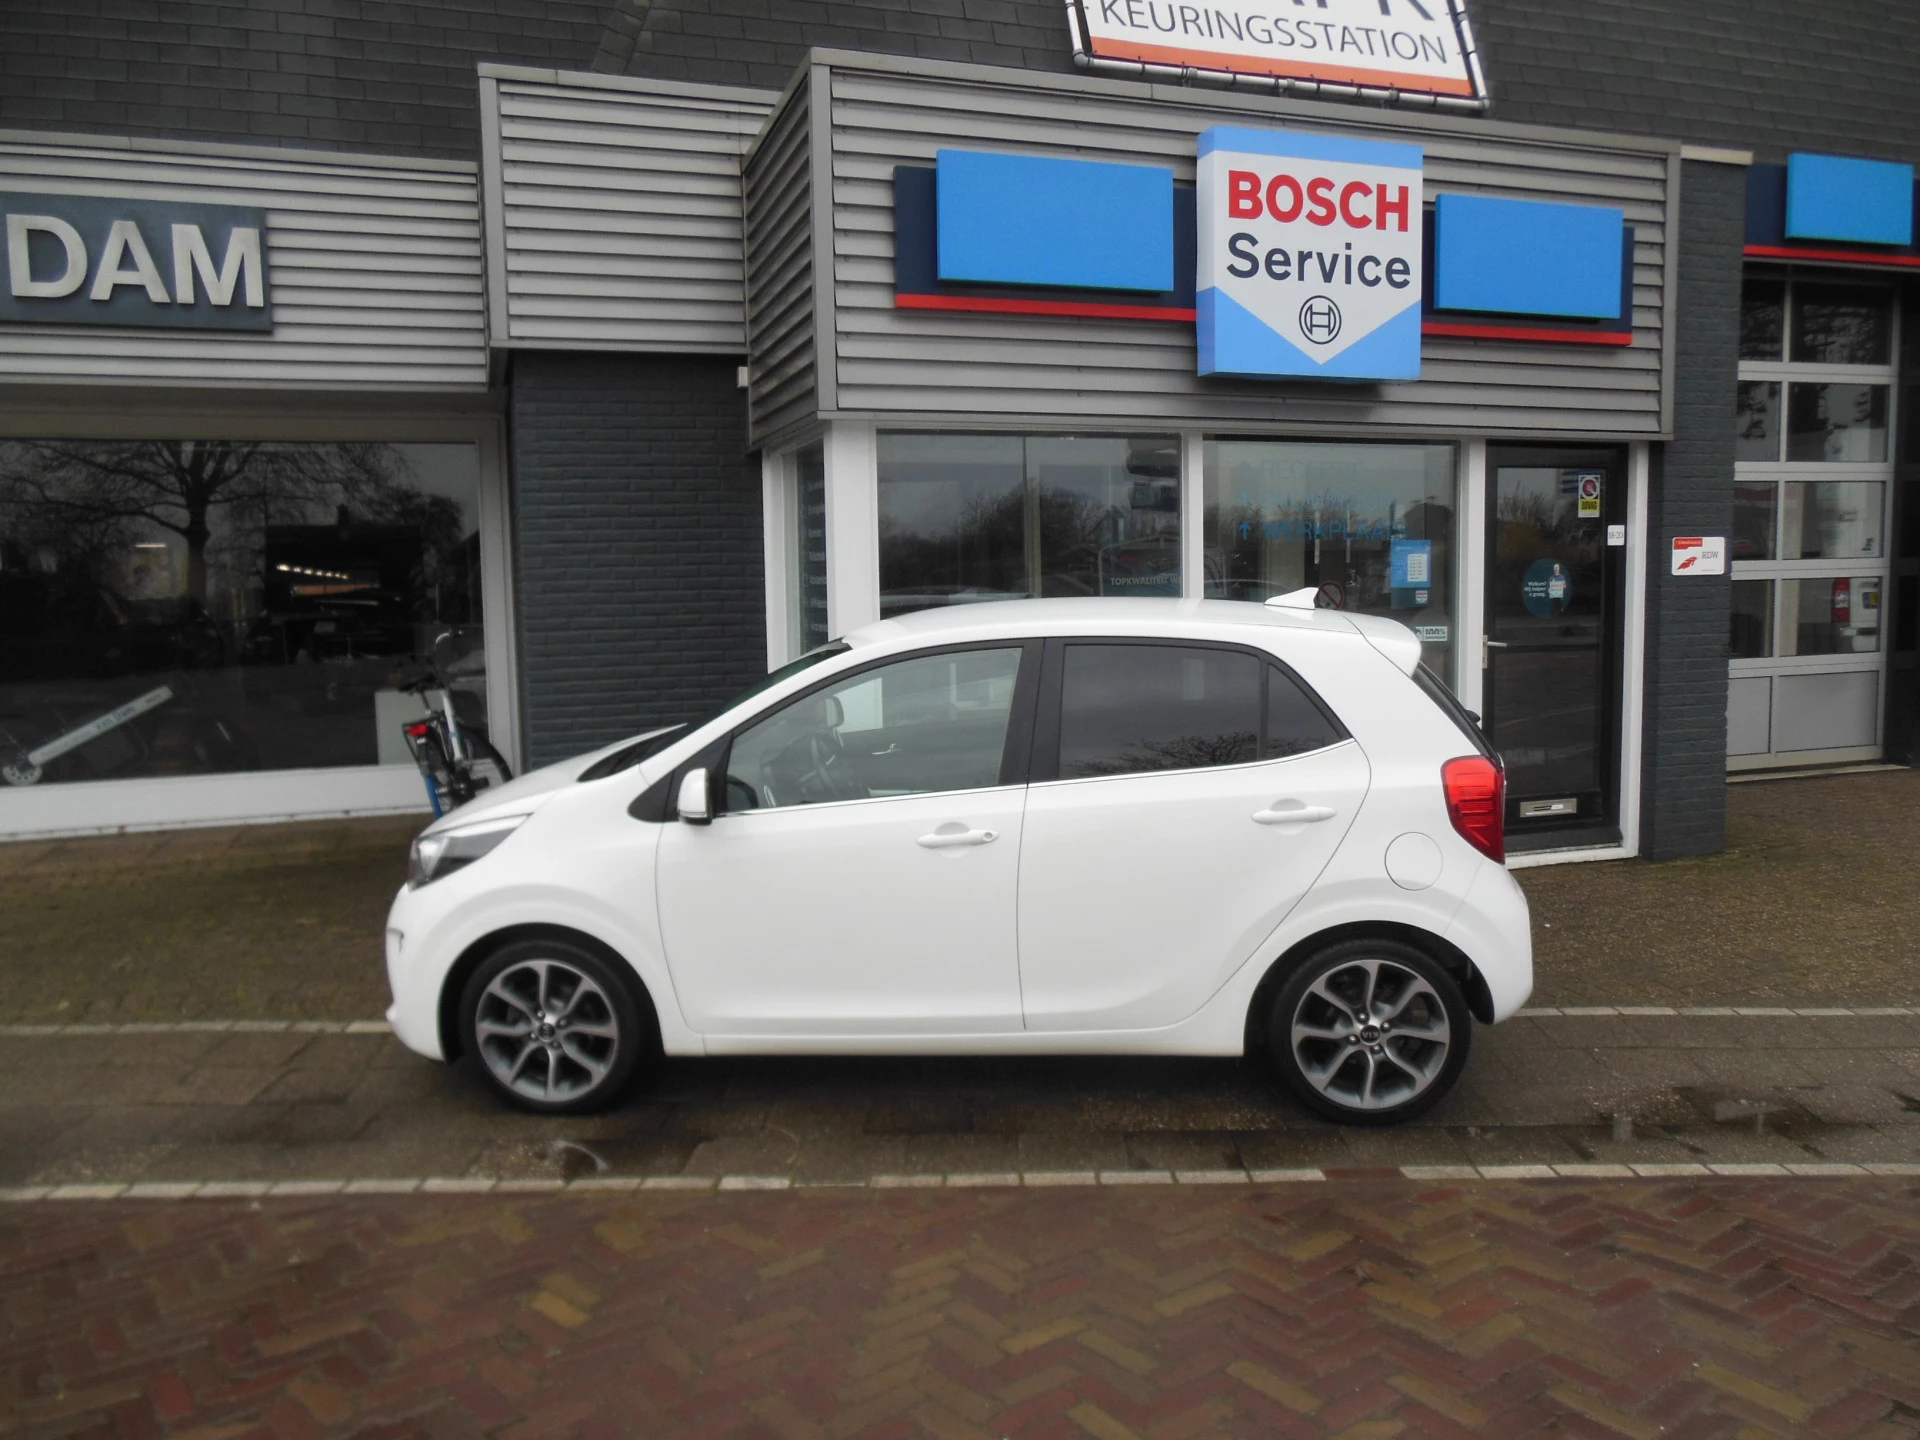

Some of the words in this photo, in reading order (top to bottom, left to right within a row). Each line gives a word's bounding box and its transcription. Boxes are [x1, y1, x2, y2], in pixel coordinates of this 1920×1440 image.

[1102, 0, 1448, 64] KEURINGSSTATION
[1228, 169, 1410, 232] BOSCH
[5, 213, 265, 308] DAM
[1226, 232, 1411, 289] Service
[1263, 521, 1408, 540] WERKPLAATS
[1701, 551, 1719, 560] RDW
